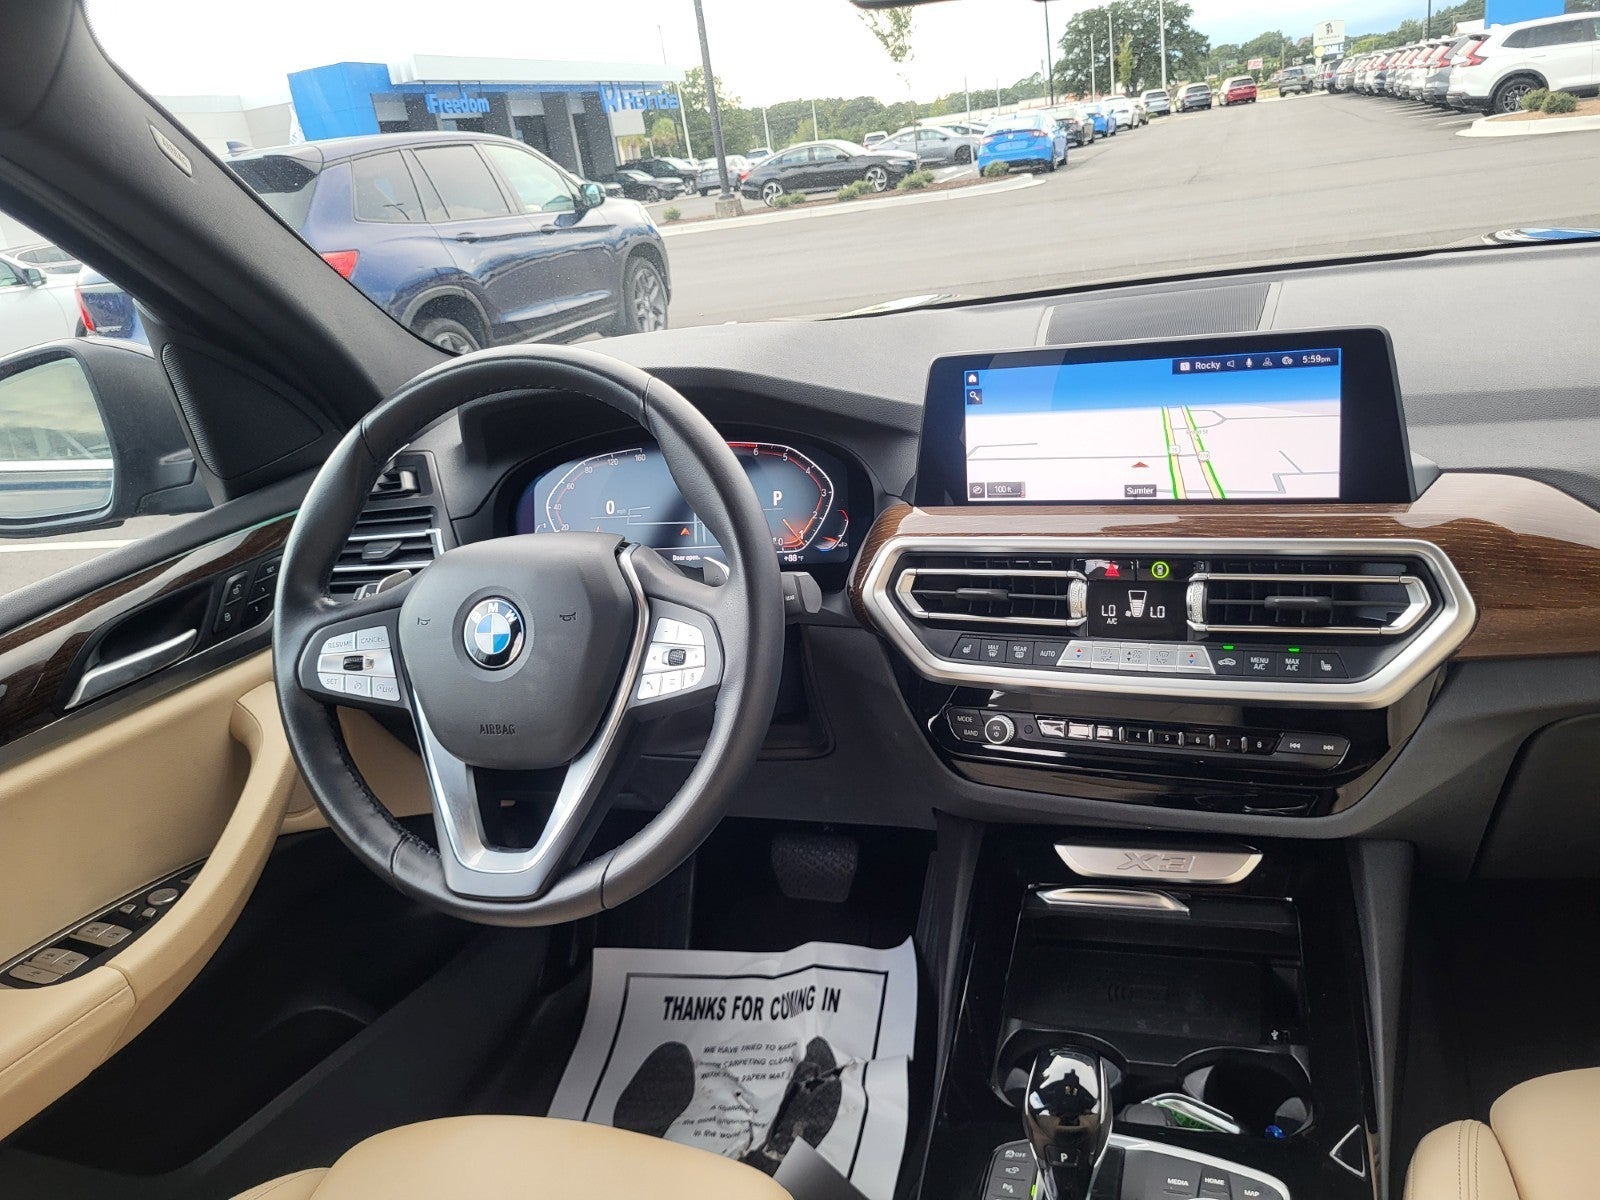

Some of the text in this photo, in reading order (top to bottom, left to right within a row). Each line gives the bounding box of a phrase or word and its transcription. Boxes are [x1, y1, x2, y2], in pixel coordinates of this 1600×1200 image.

[425, 92, 491, 114] Freedom
[621, 91, 680, 110] Honda
[1302, 355, 1331, 364] 5:59pm
[1195, 361, 1221, 370] Rocky
[635, 454, 646, 462] 160
[782, 453, 788, 461] 5
[567, 482, 574, 490] 60
[994, 485, 1006, 493] 100
[821, 489, 827, 497] 3
[1126, 487, 1154, 495] Sumter
[773, 490, 783, 506] P
[553, 503, 562, 511] 40
[606, 500, 615, 515] 0
[812, 511, 818, 520] 2
[799, 530, 804, 540] 1
[777, 538, 784, 546] 0
[470, 602, 518, 625] BMW
[1101, 604, 1116, 617] LO
[1150, 606, 1165, 618] LO
[1106, 617, 1118, 625] A/C
[327, 640, 353, 650] RESUME
[360, 636, 385, 645] CANCEL
[1040, 650, 1056, 658] AUTO
[1250, 656, 1270, 664] MENU
[1253, 663, 1266, 671] A/C
[1286, 664, 1299, 672] A/C
[957, 715, 973, 723] MODE
[479, 723, 516, 735] AIRBAG
[963, 729, 979, 737] BAND
[1164, 734, 1170, 742] 5
[1195, 736, 1201, 744] 6
[1226, 738, 1231, 746] 7
[1256, 741, 1263, 749] 8
[1116, 851, 1196, 873] X3
[663, 995, 727, 1021] THANKS
[731, 995, 764, 1021] FOR
[821, 986, 841, 1013] IN
[718, 1045, 738, 1053] HAVE
[741, 1043, 762, 1051] TRIED
[769, 1071, 785, 1080] MAT
[1060, 1152, 1068, 1162] P
[1167, 1178, 1189, 1187] MEDIA
[1204, 1177, 1225, 1186] HOME
[1244, 1189, 1260, 1197] MAP
